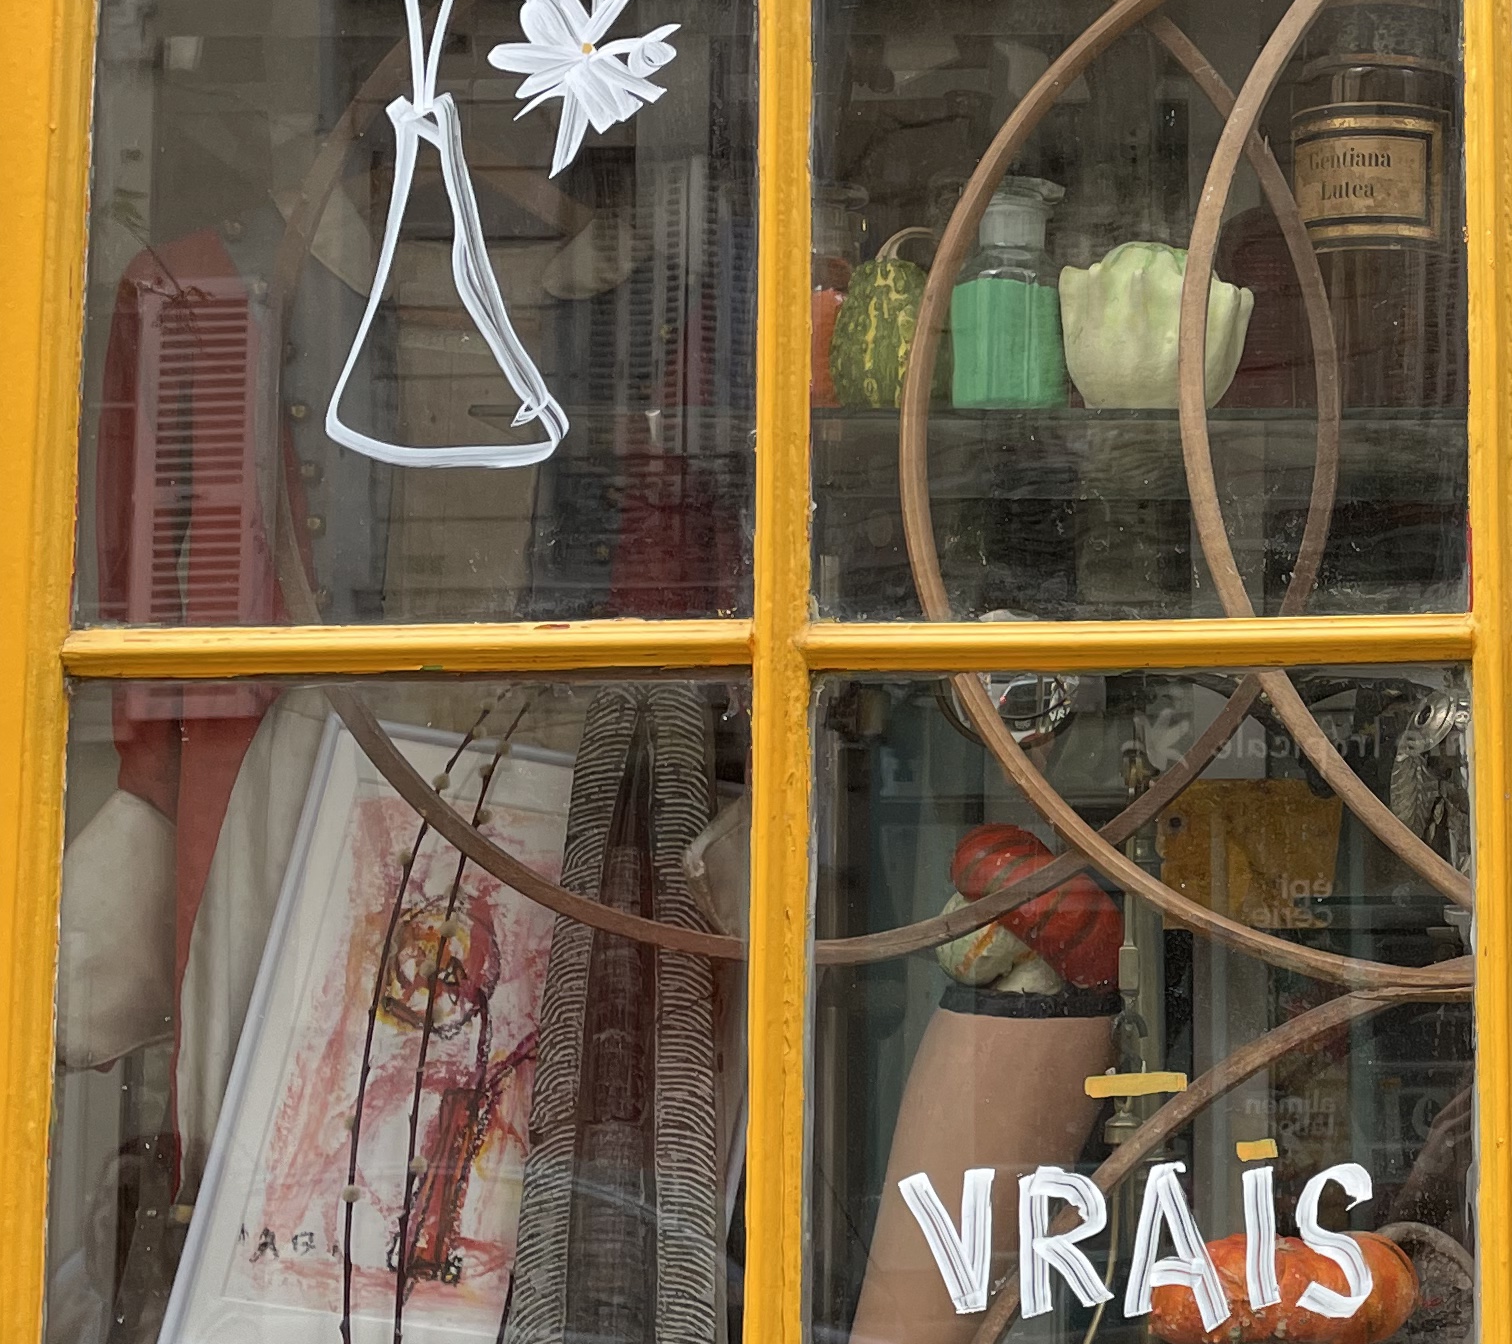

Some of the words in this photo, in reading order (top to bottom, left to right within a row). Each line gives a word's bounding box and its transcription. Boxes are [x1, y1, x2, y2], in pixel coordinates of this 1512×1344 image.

[1309, 147, 1392, 170] Gentiana
[1320, 181, 1376, 201] Lutea
[897, 1138, 1374, 1332] VRAIS
